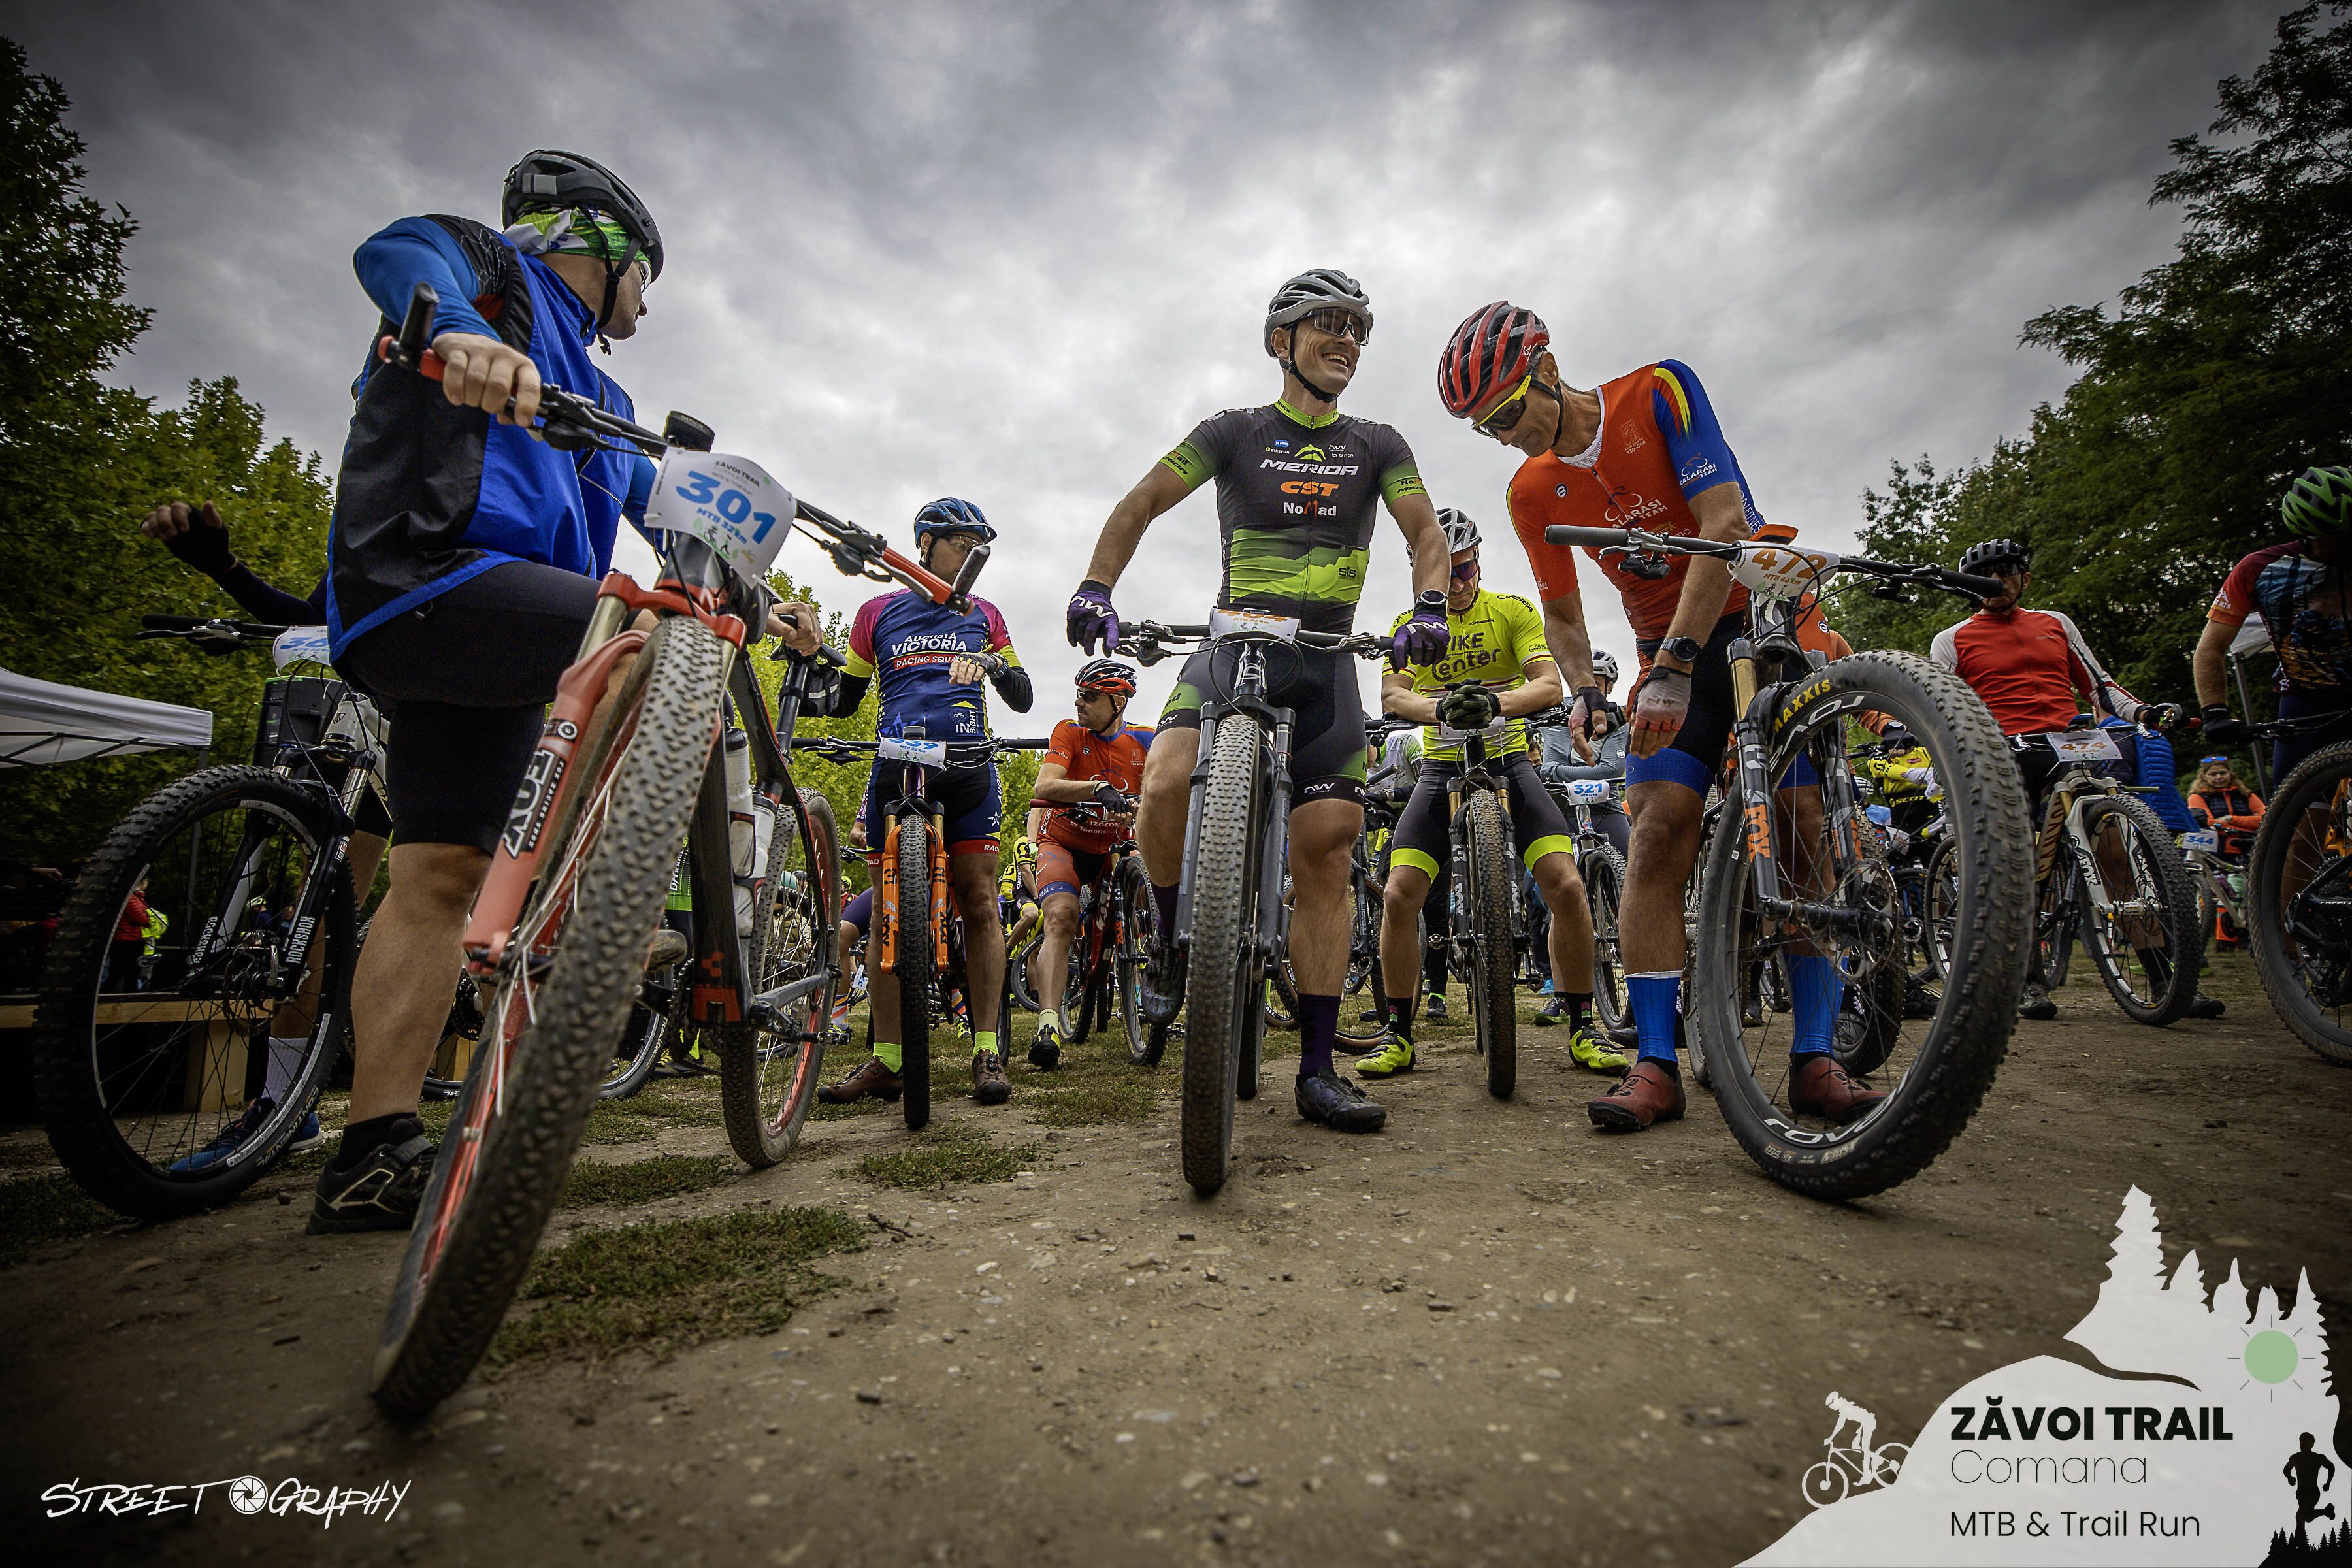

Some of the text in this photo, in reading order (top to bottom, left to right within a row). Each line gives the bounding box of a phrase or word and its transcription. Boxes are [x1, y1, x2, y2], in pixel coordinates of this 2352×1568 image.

[1260, 459, 1358, 476] MERIDA
[1699, 468, 1718, 478] TEAM
[1281, 480, 1339, 497] CST
[676, 470, 776, 544] 301
[696, 507, 721, 523] MTB
[1284, 500, 1337, 523] NoMad
[1639, 505, 1668, 519] TEAM
[1752, 548, 1827, 580] 472
[1497, 595, 1533, 613] ORBEA
[904, 632, 957, 643] AUGUSTA
[1451, 632, 1485, 651] IKE
[892, 638, 967, 655] VICTORIA
[896, 655, 959, 668] RACING SQUA
[1774, 679, 1831, 732] MAXXIS
[2061, 742, 2107, 751] 474
[1574, 783, 1602, 794] 321
[502, 749, 555, 859] FOX
[1895, 794, 1925, 804] SCOT
[1745, 804, 1771, 862] FOX
[2187, 836, 2214, 845] 344
[286, 915, 316, 964] ROCKSHOX
